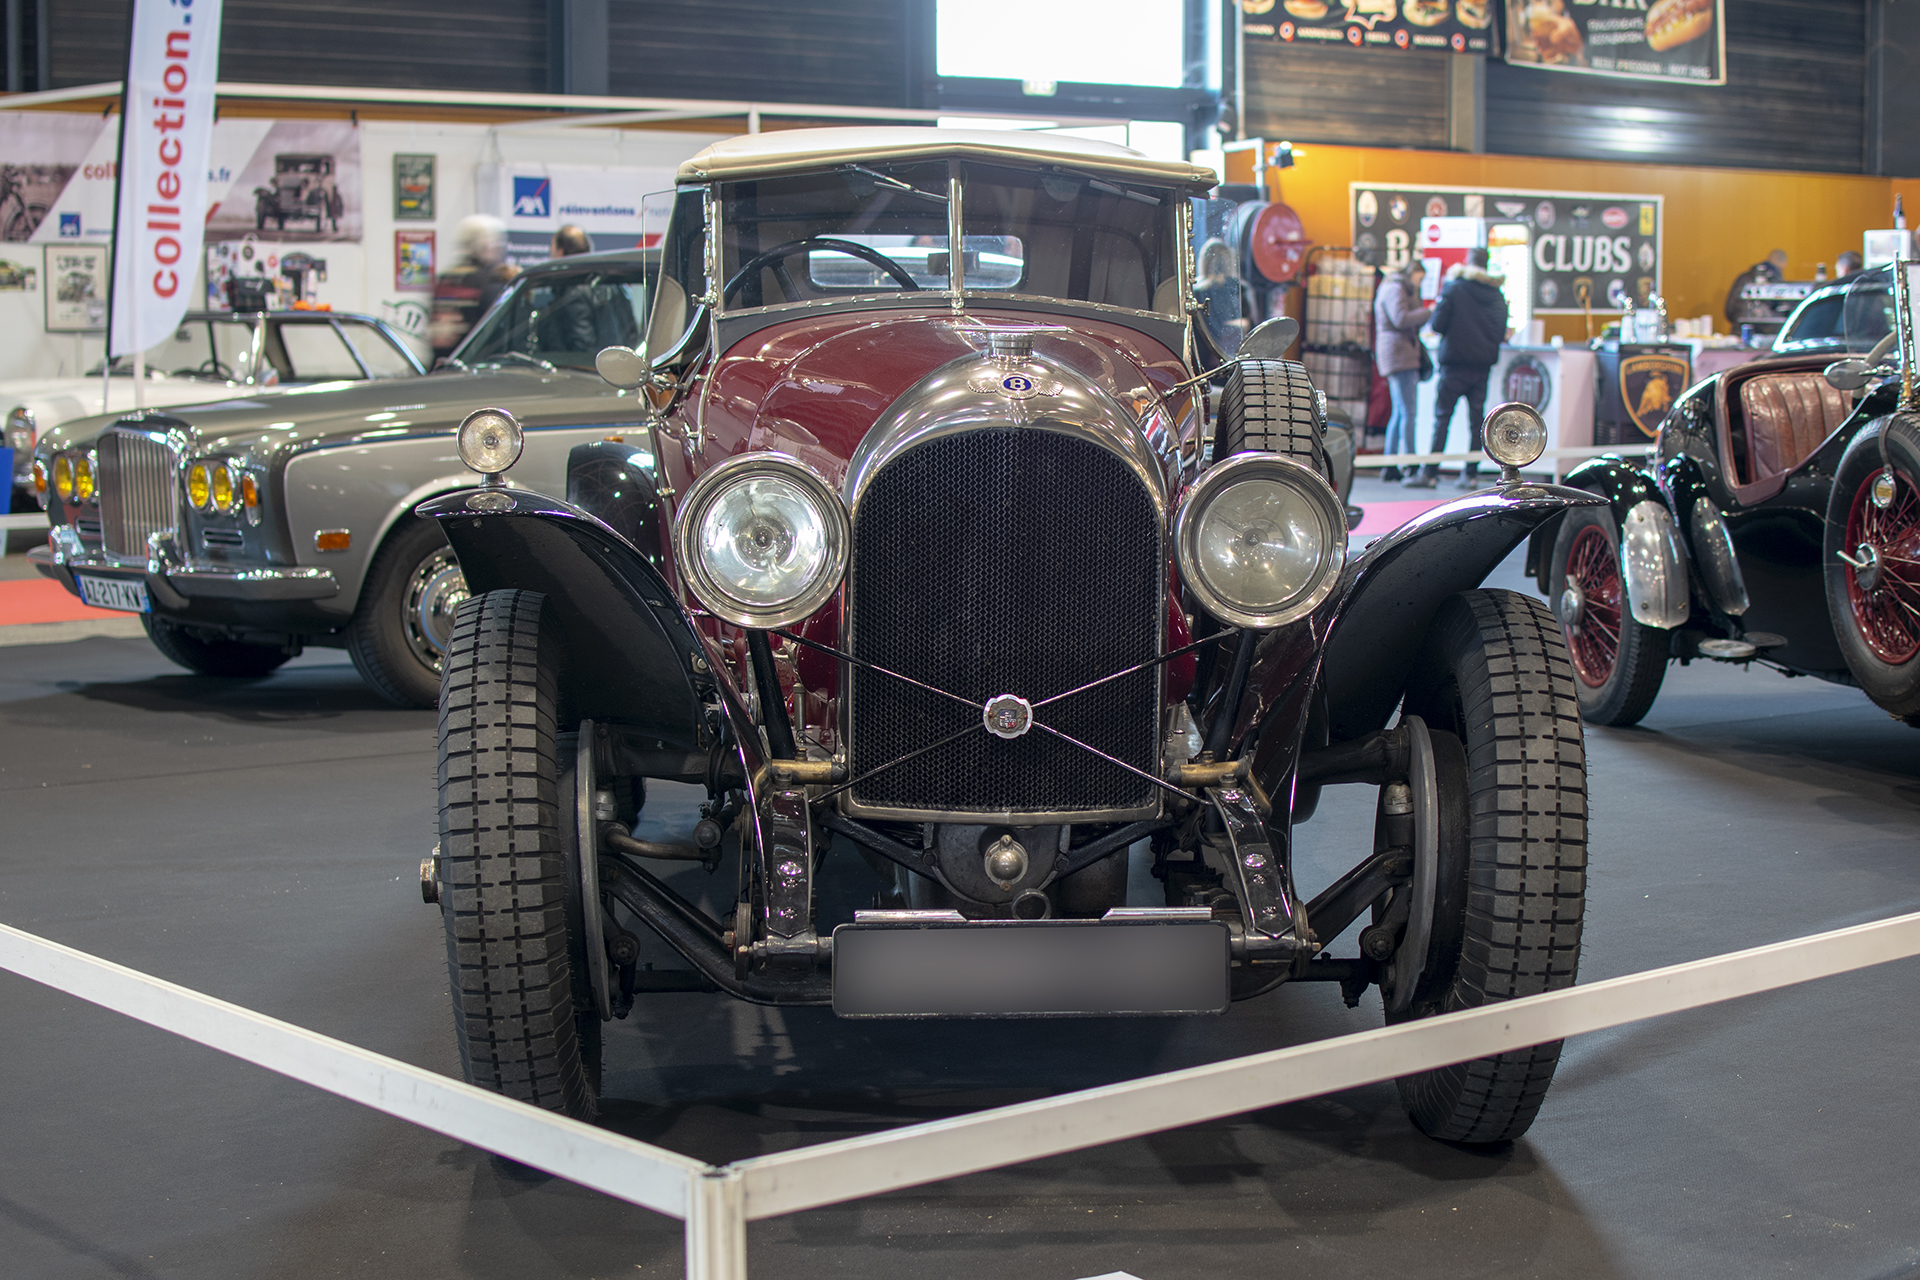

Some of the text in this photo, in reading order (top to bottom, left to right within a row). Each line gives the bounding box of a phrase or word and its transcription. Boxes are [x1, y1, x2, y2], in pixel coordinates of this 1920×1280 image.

[146, 0, 194, 299] collection.
[513, 195, 546, 215] AXA
[1533, 233, 1632, 274] CLUBS
[1009, 378, 1026, 389] B
[1508, 372, 1541, 401] FIAT
